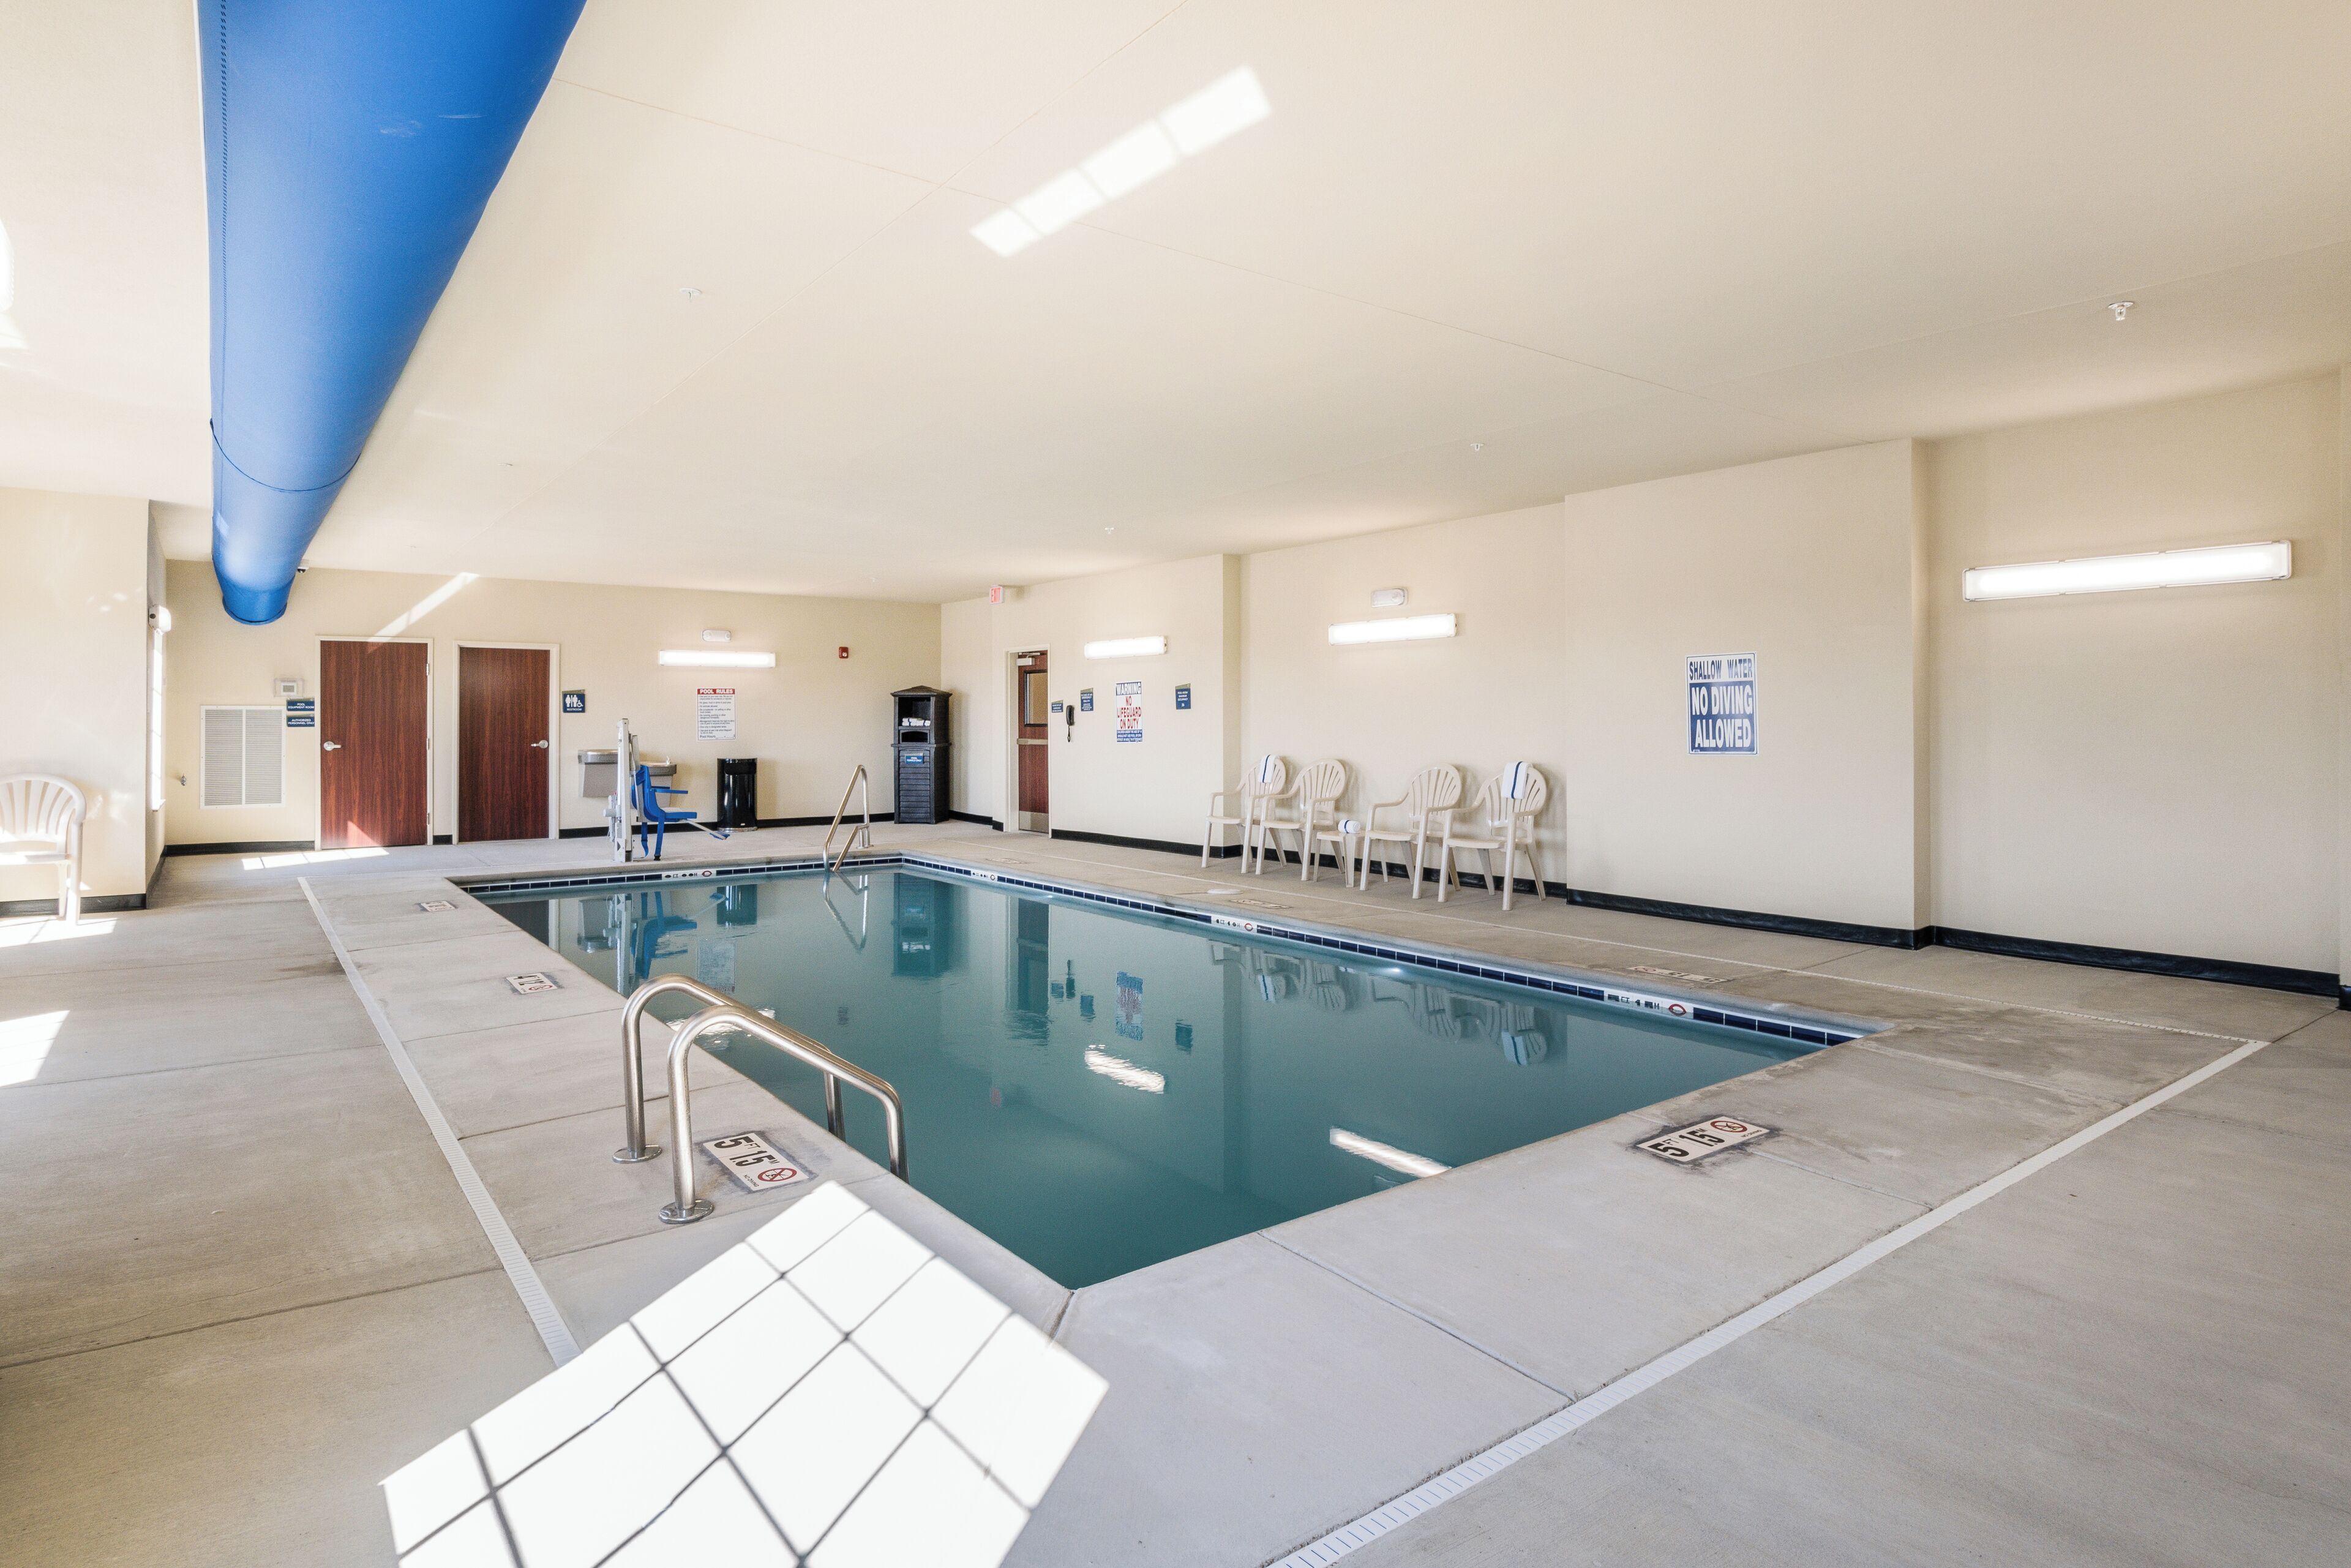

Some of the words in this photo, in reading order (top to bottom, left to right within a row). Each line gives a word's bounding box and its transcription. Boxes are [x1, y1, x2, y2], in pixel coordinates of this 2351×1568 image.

[991, 588, 1001, 603] EXIT
[1689, 660, 1722, 680] SHALLOW
[1727, 658, 1752, 678] WATER
[1117, 683, 1141, 695] WARNING
[1125, 696, 1132, 706] NO
[1692, 686, 1708, 715] NO
[1711, 685, 1753, 715] DIVING
[1117, 707, 1141, 718] LIFEGUARD
[1120, 719, 1127, 729] ON
[1127, 718, 1139, 729] DUTY
[1695, 718, 1752, 748] ALLOWED
[714, 1136, 755, 1149] 5
[1678, 1130, 1725, 1147] 1.5
[1647, 1142, 1690, 1157] 5
[729, 1150, 776, 1167] 1.5
[748, 1178, 759, 1187] DIVING
